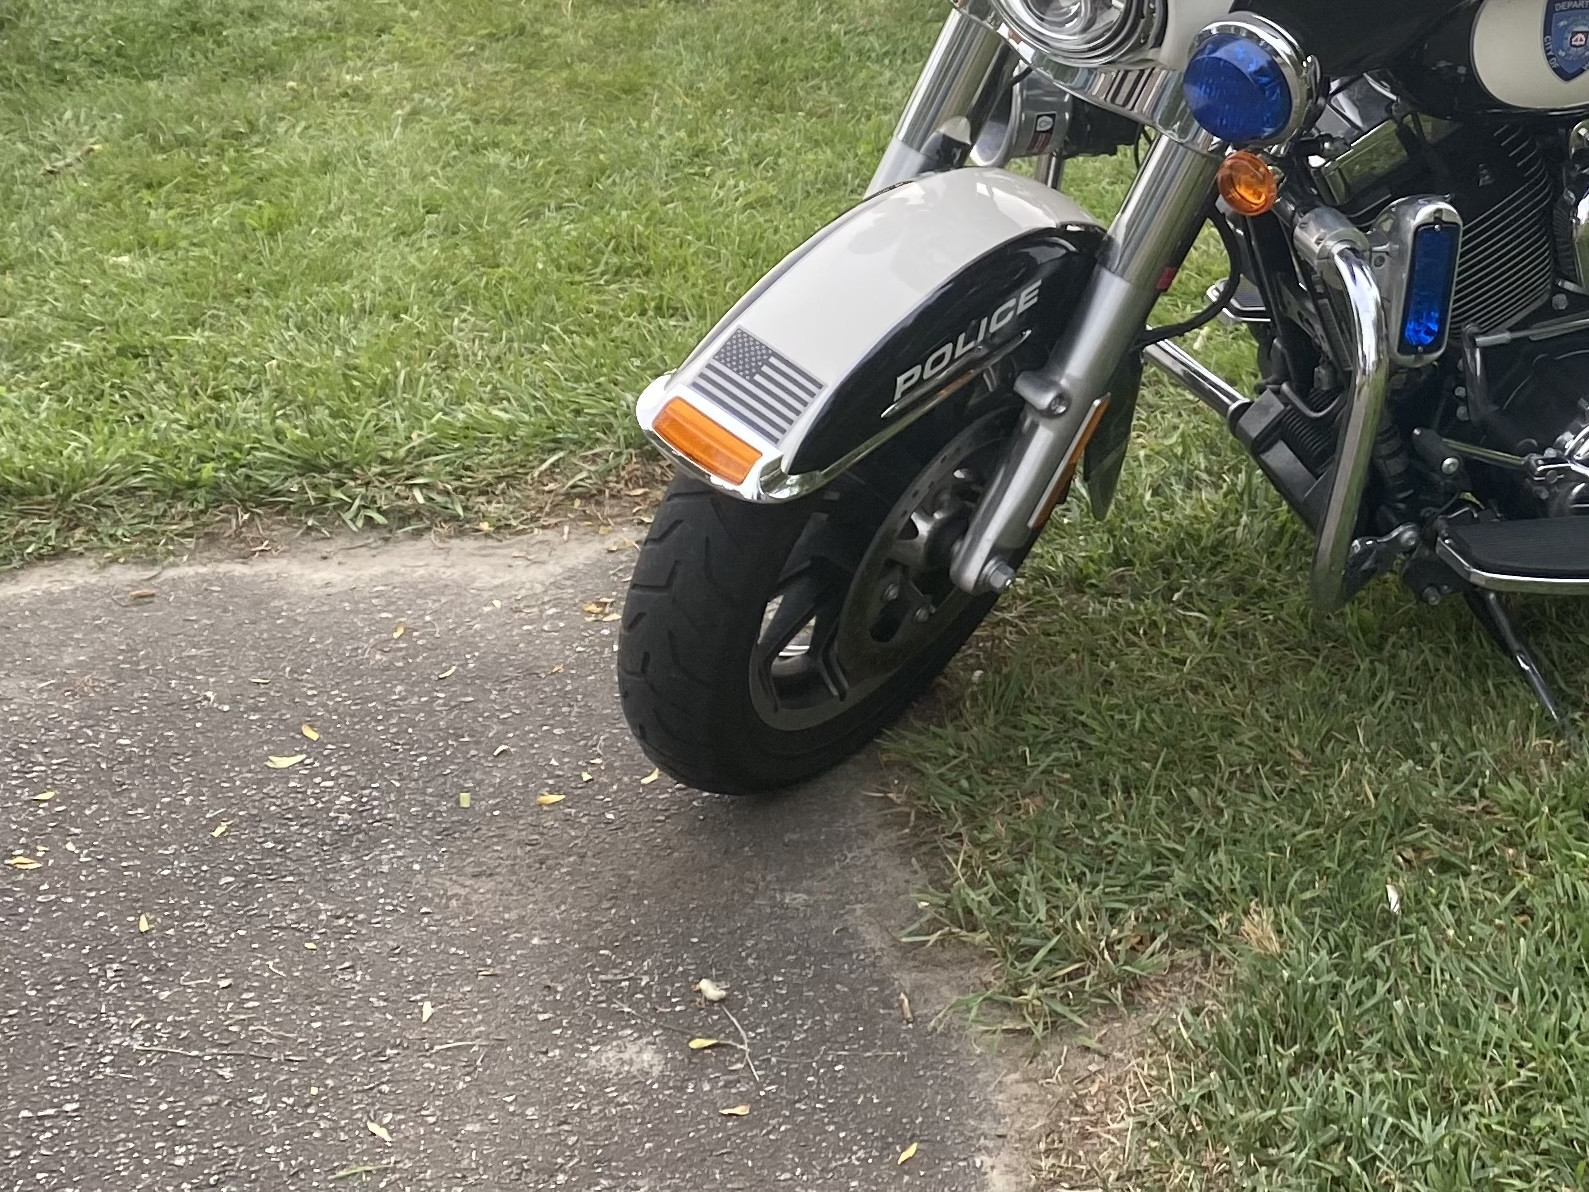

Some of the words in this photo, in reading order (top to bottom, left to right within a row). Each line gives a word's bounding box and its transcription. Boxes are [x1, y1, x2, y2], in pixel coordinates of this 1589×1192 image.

[1544, 35, 1555, 56] CITY
[1549, 57, 1559, 68] OF
[893, 279, 1042, 402] POLICE
